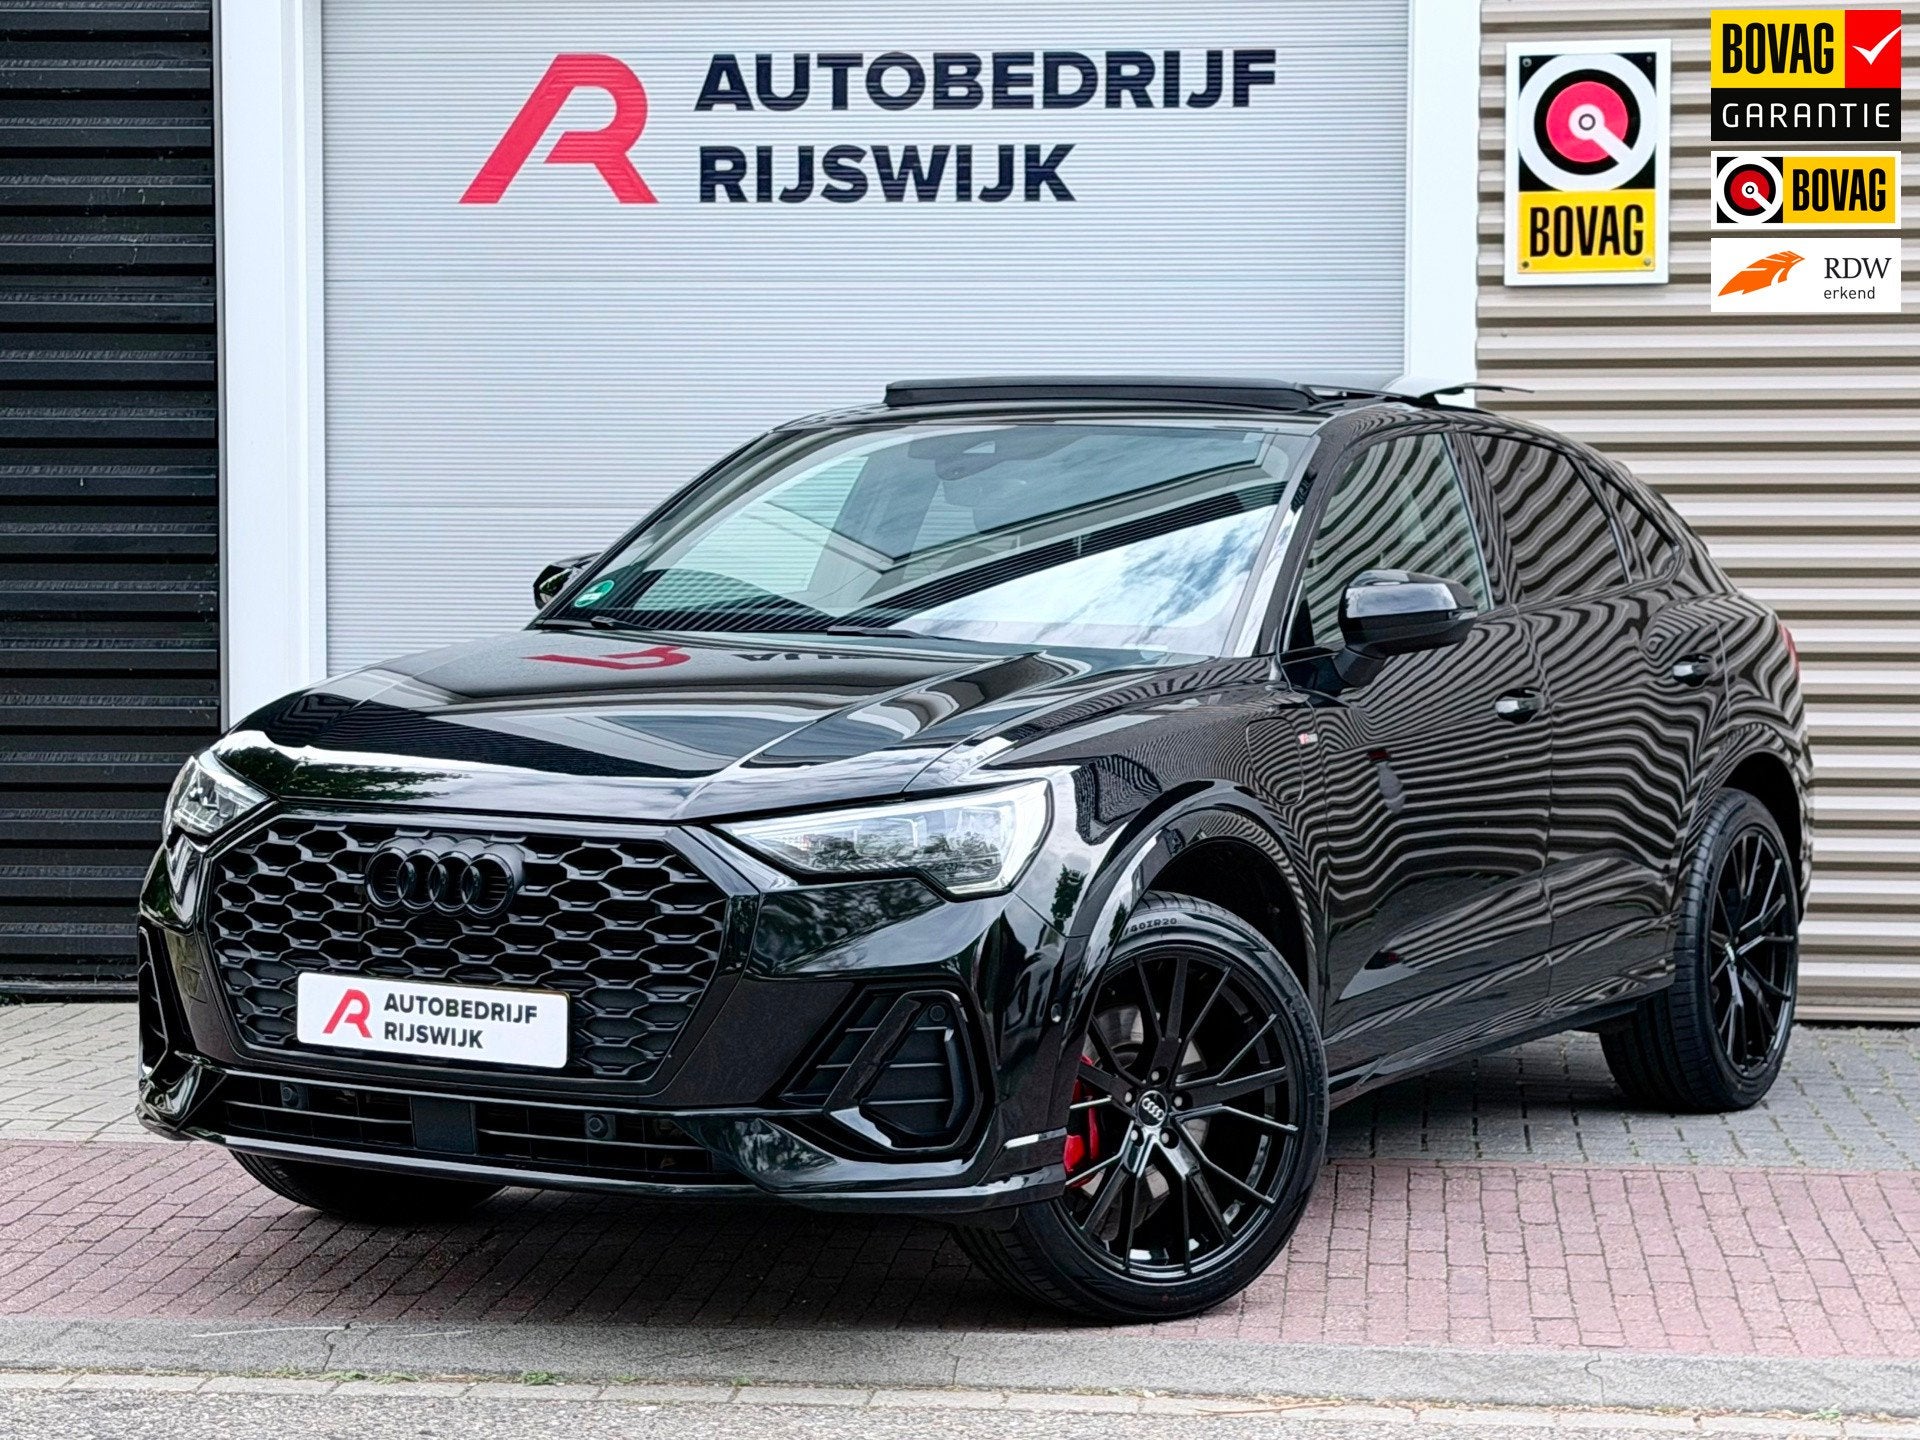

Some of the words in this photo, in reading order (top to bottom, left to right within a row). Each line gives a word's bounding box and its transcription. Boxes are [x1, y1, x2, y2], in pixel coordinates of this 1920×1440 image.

[695, 49, 1276, 112] AUTOBEDRIJF
[699, 144, 1077, 204] RIJSWIJK
[1529, 204, 1645, 258] BOVAG
[383, 993, 538, 1024] AUTOBEDRIJF
[383, 1021, 483, 1049] RIJSWIJK
